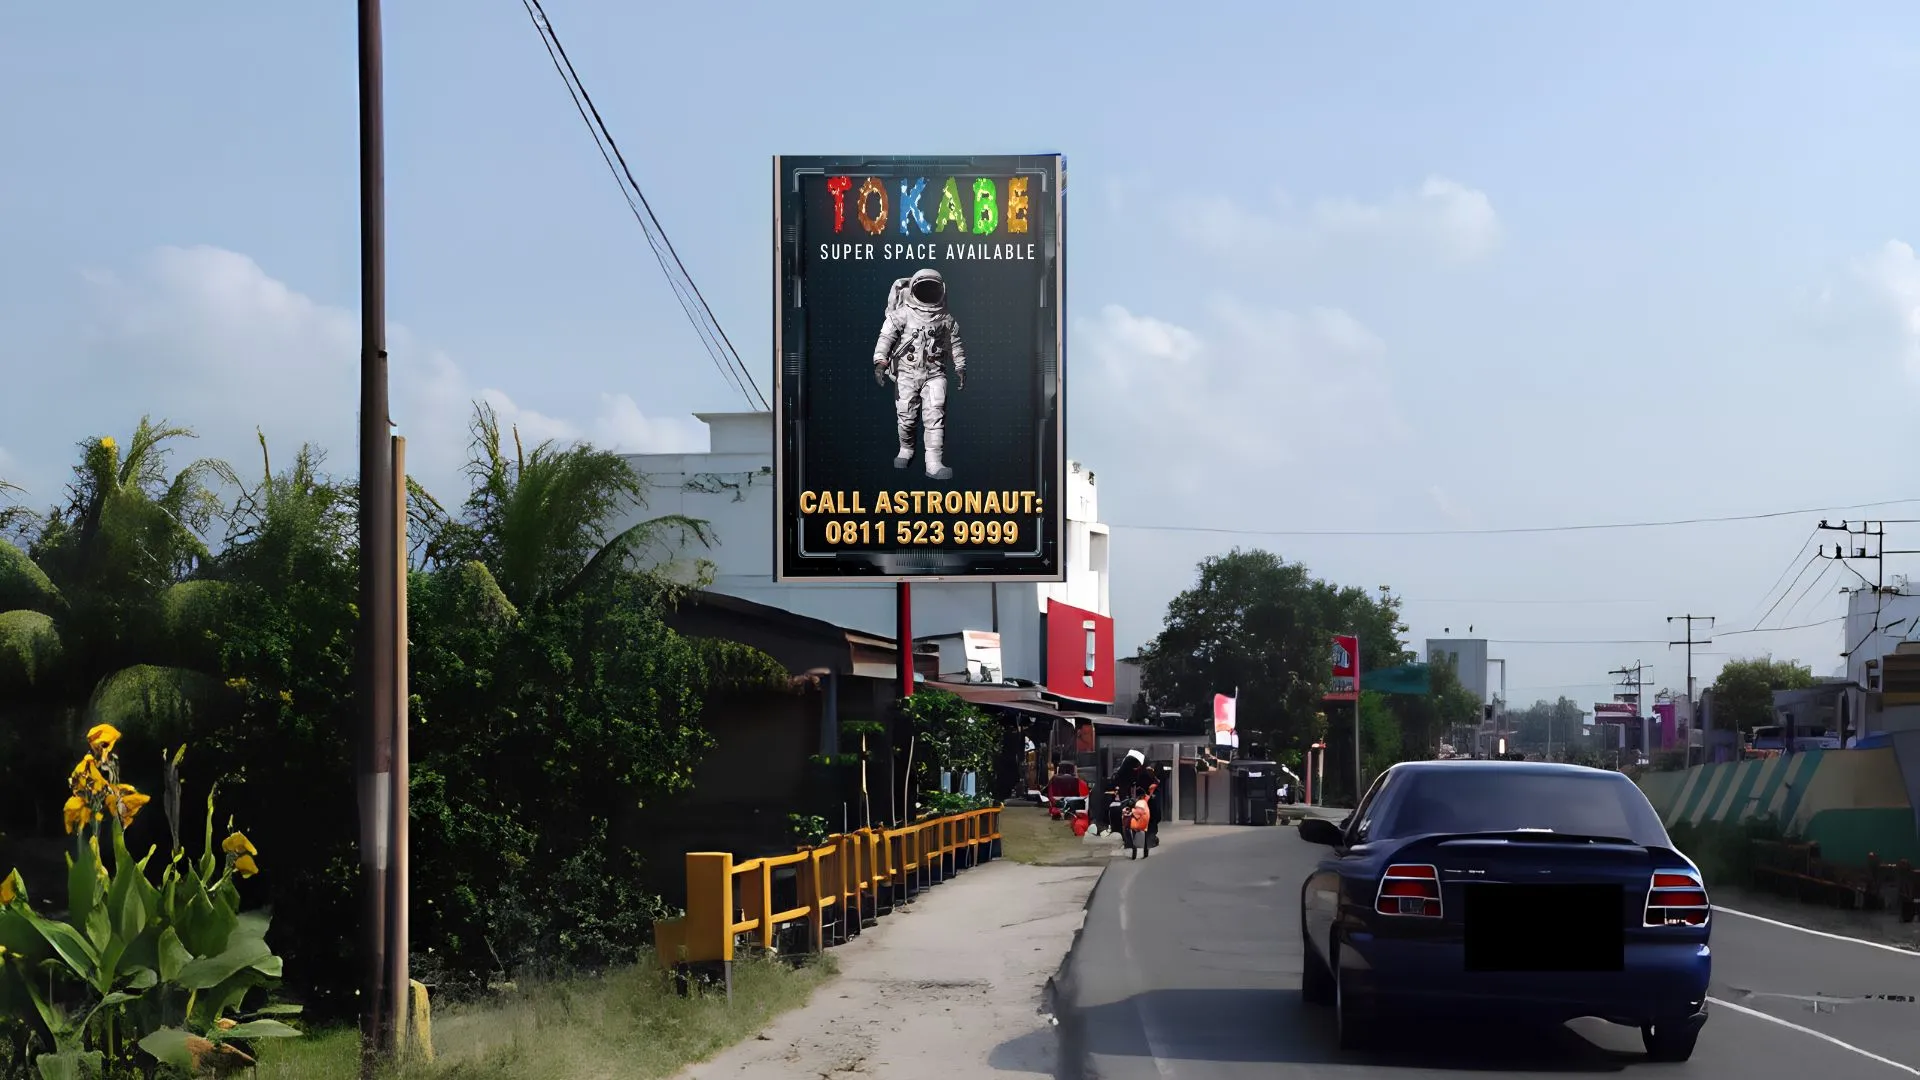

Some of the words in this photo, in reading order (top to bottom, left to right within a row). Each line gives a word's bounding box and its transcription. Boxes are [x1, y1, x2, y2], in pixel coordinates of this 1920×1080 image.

[827, 176, 1029, 235] TOKABE
[820, 244, 875, 260] SUPER
[884, 244, 937, 260] SPACE
[946, 244, 1035, 260] AVAILABLE
[800, 490, 866, 514] CALL
[875, 490, 1043, 514] ASTRONAUT:
[825, 521, 885, 545] 0811
[897, 521, 945, 545] 523
[954, 521, 1018, 545] 9999
